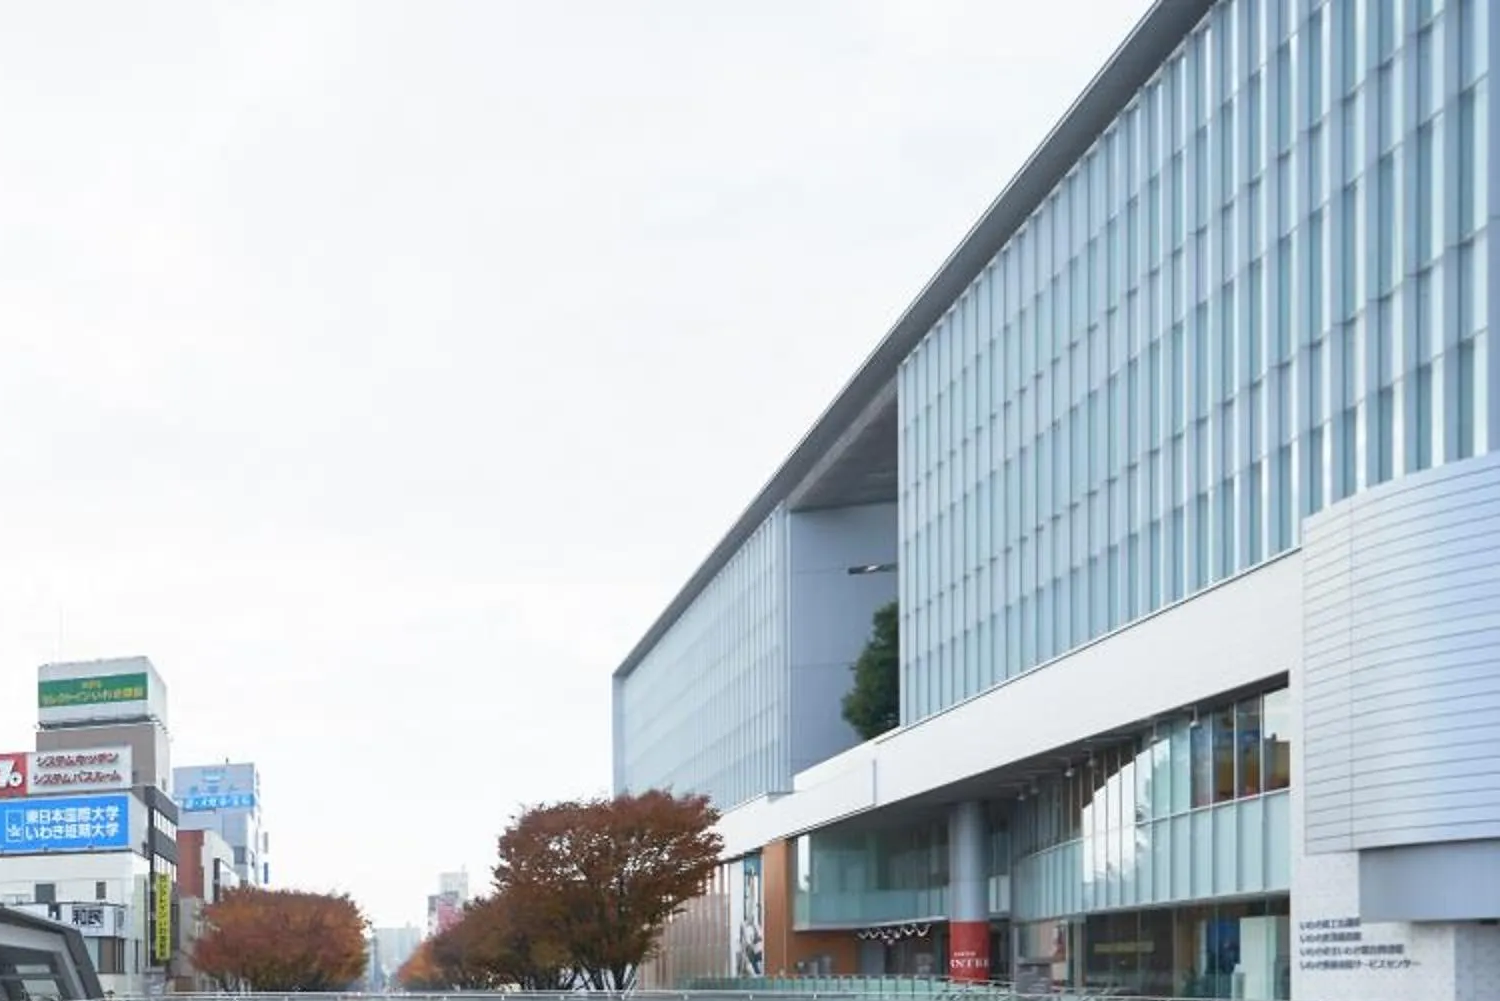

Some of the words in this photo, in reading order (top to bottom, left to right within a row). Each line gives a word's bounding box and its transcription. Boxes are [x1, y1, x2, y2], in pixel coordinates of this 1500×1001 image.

[36, 753, 120, 768] システムキッチン
[34, 770, 122, 785] システムバスルーム
[26, 806, 120, 824] 東日本国際大学
[25, 823, 120, 841] いわき短期大学
